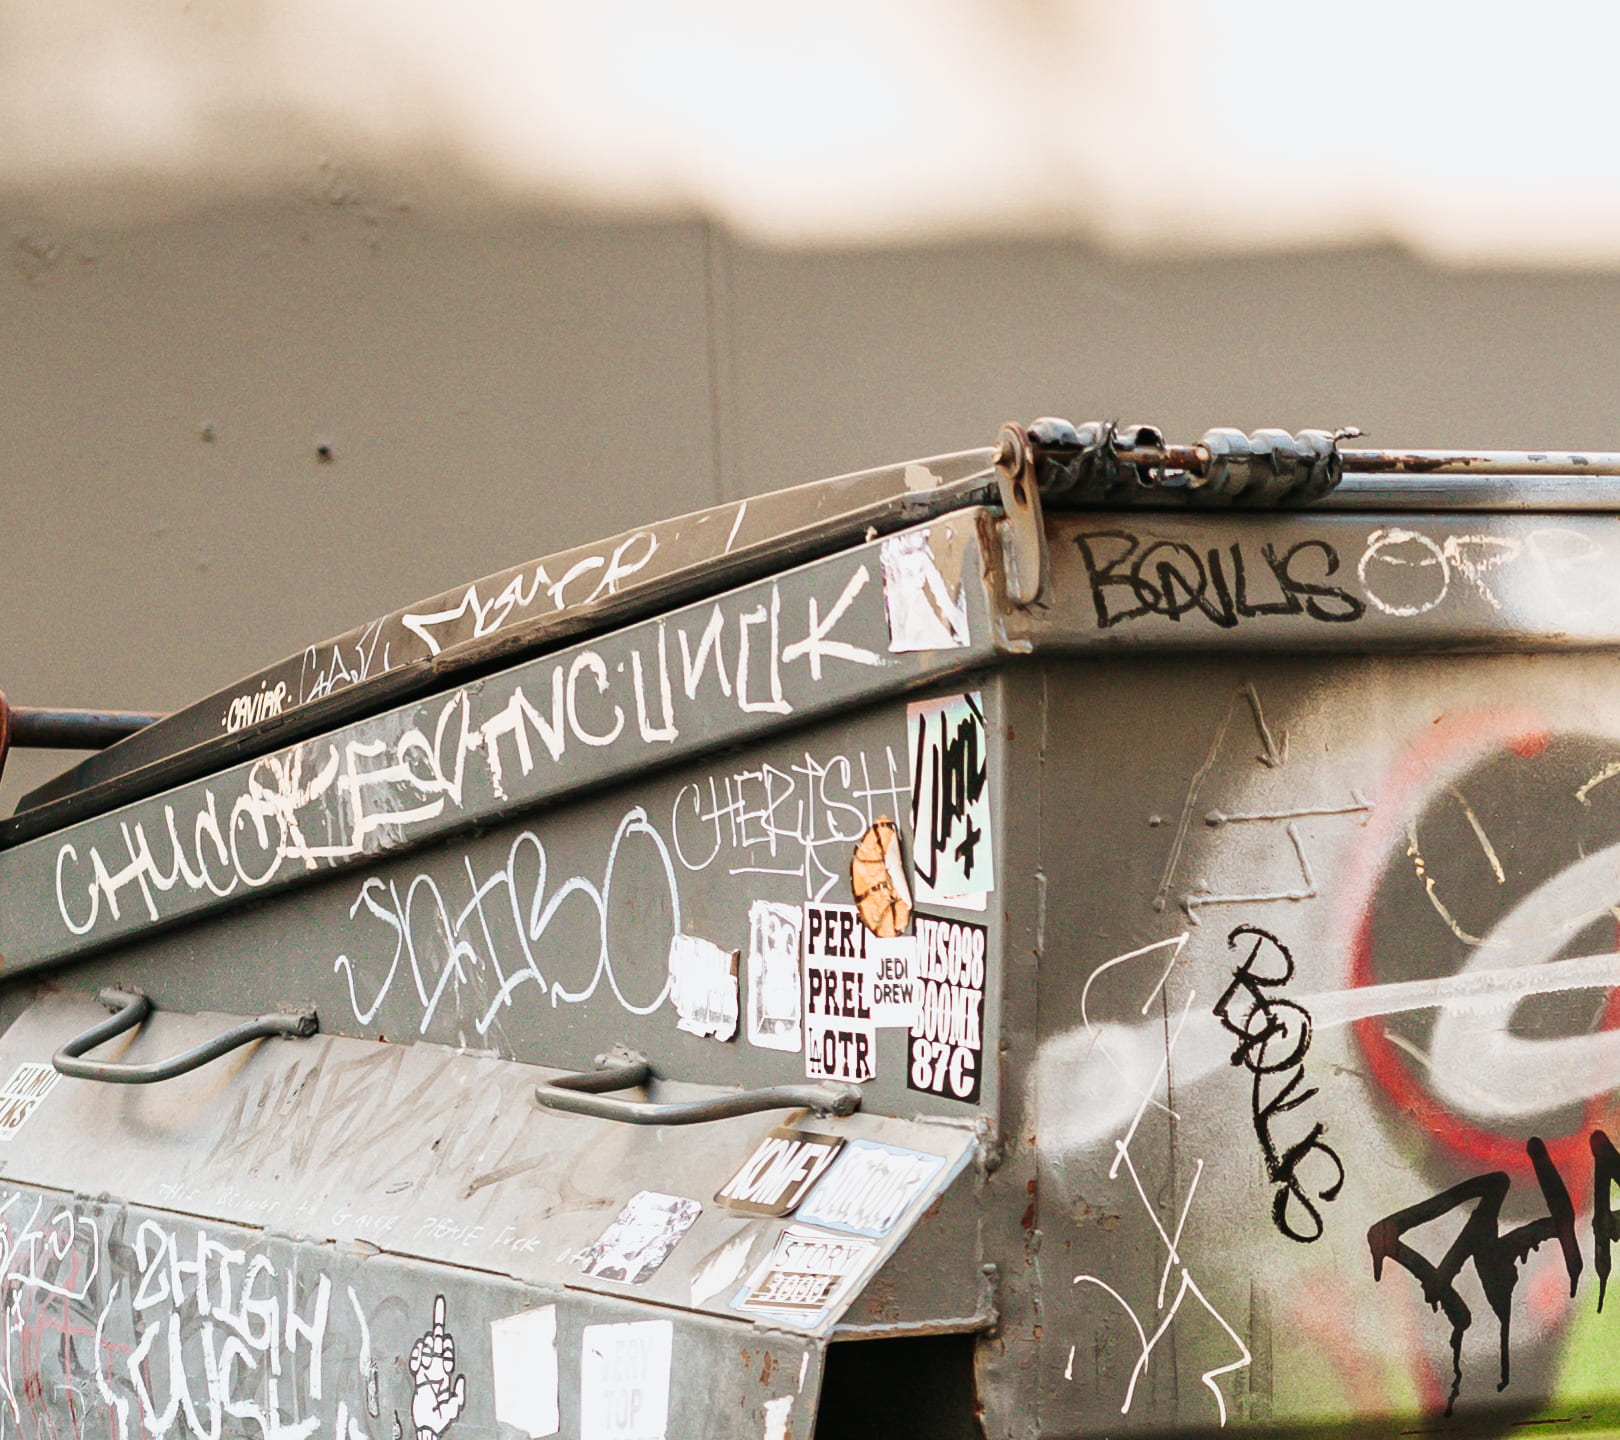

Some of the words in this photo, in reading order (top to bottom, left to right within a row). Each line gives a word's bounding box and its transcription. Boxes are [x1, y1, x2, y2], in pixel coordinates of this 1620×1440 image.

[672, 746, 914, 870] CHERISH
[807, 967, 871, 1020] PREL
[876, 957, 909, 981] JEDI
[873, 983, 914, 1005] DREW
[911, 1038, 975, 1098] 87C
[719, 1136, 841, 1209] KOMFY
[775, 1241, 866, 1268] STORY
[603, 1387, 643, 1432] TOP
